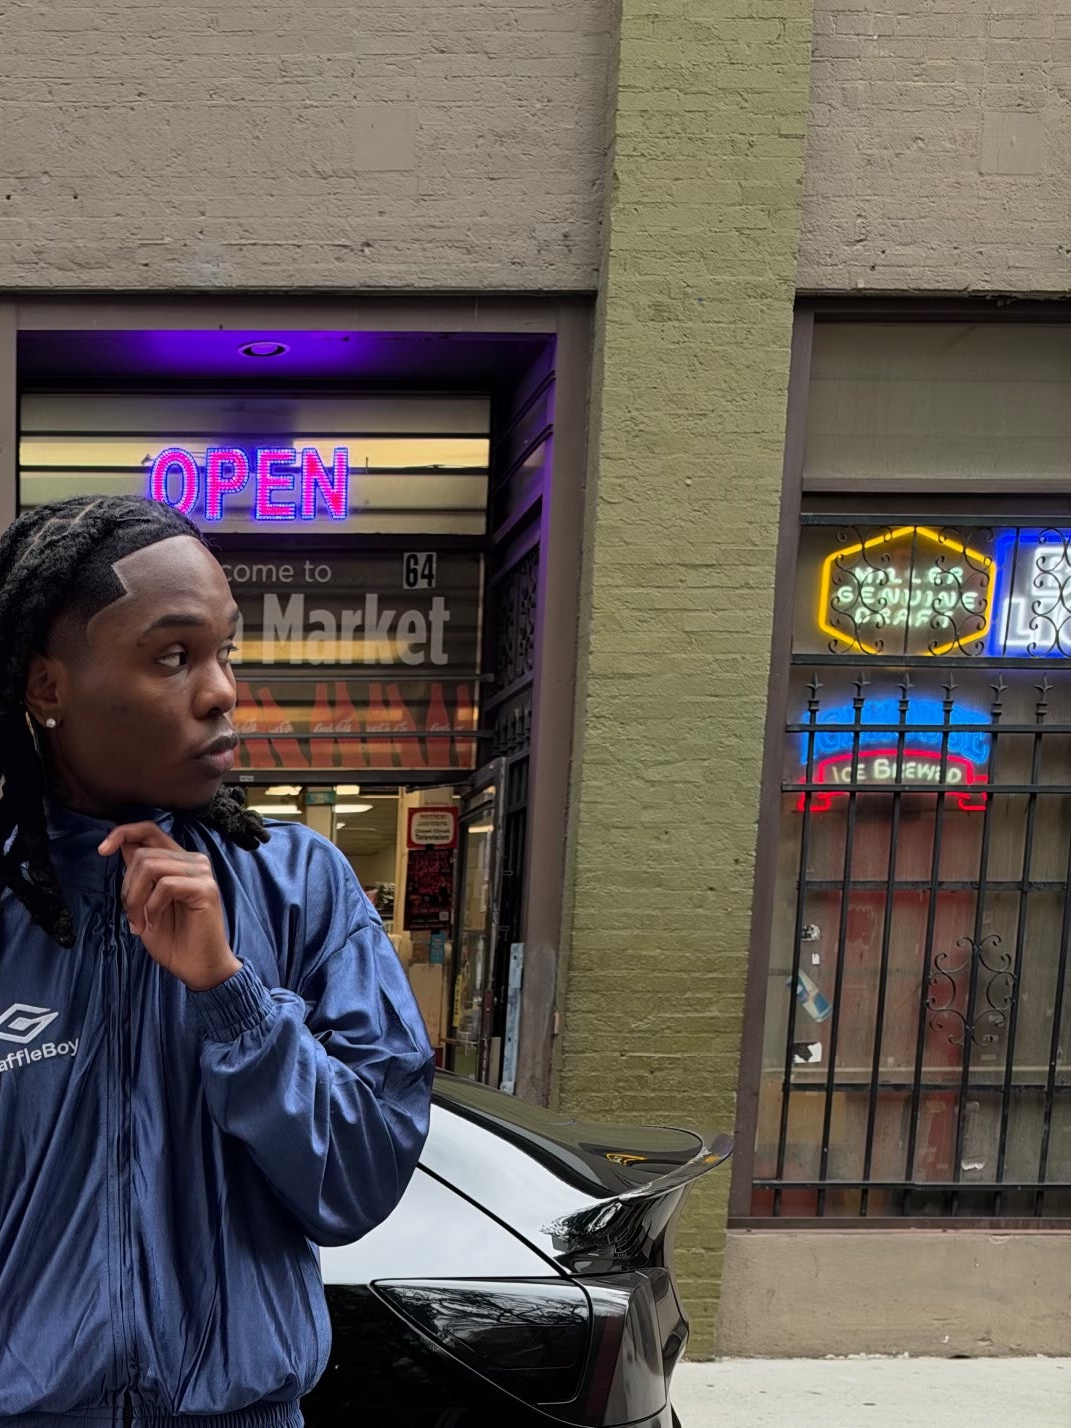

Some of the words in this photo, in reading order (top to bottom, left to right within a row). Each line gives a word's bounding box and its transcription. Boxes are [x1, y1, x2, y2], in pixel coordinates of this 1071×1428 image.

[150, 446, 350, 521] OPEN
[221, 562, 294, 583] come
[304, 560, 332, 583] to
[405, 553, 435, 588] 64
[837, 586, 979, 610] GENUINE
[262, 593, 450, 665] Market
[855, 607, 953, 628] DRAFT
